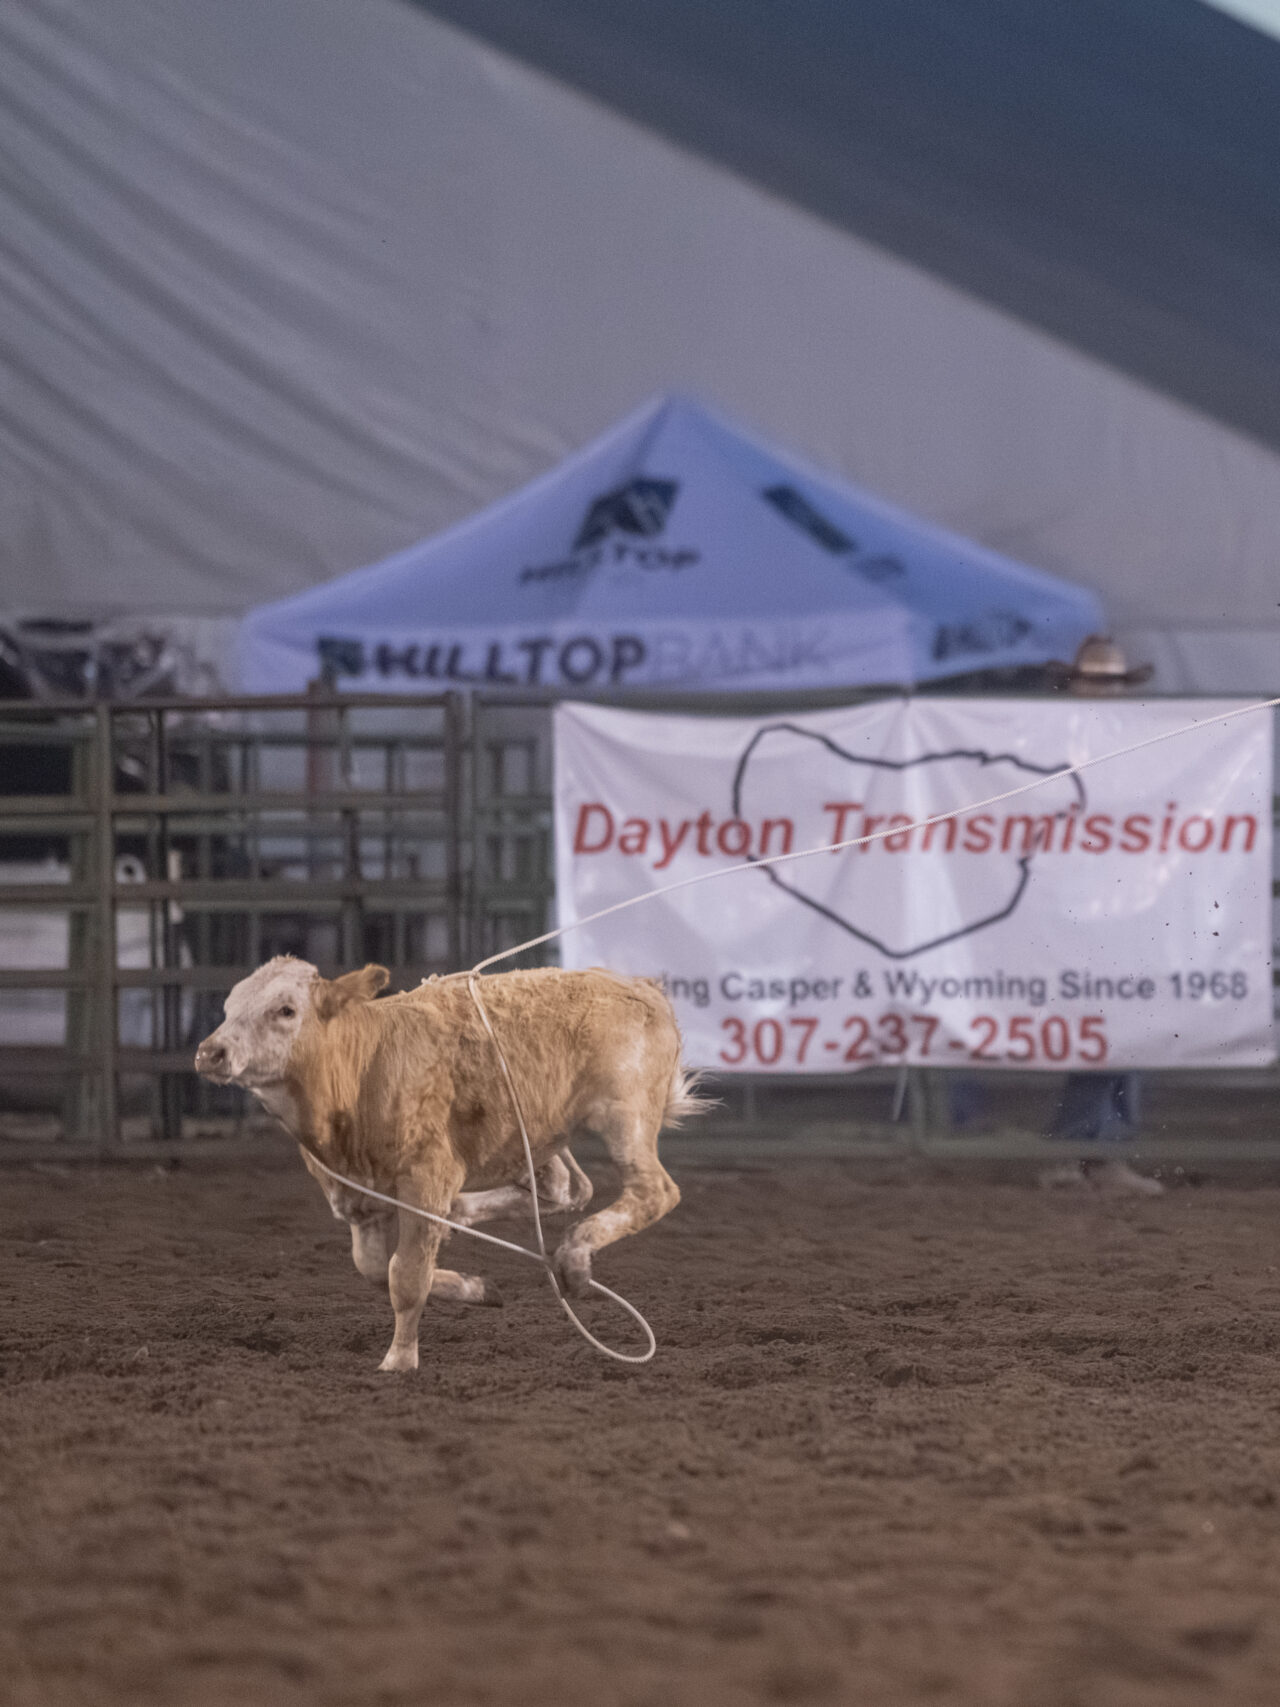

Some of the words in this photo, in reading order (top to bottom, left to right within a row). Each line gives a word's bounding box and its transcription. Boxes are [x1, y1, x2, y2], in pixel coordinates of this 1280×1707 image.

[573, 802, 794, 870] Dayton
[823, 801, 1258, 855] Transmission
[719, 971, 844, 1008] Casper
[853, 970, 874, 999] &
[884, 969, 1047, 1006] Wyoming
[1059, 969, 1156, 1000] Since
[1169, 970, 1248, 1000] 1968
[719, 1012, 1109, 1065] 307-237-2505
